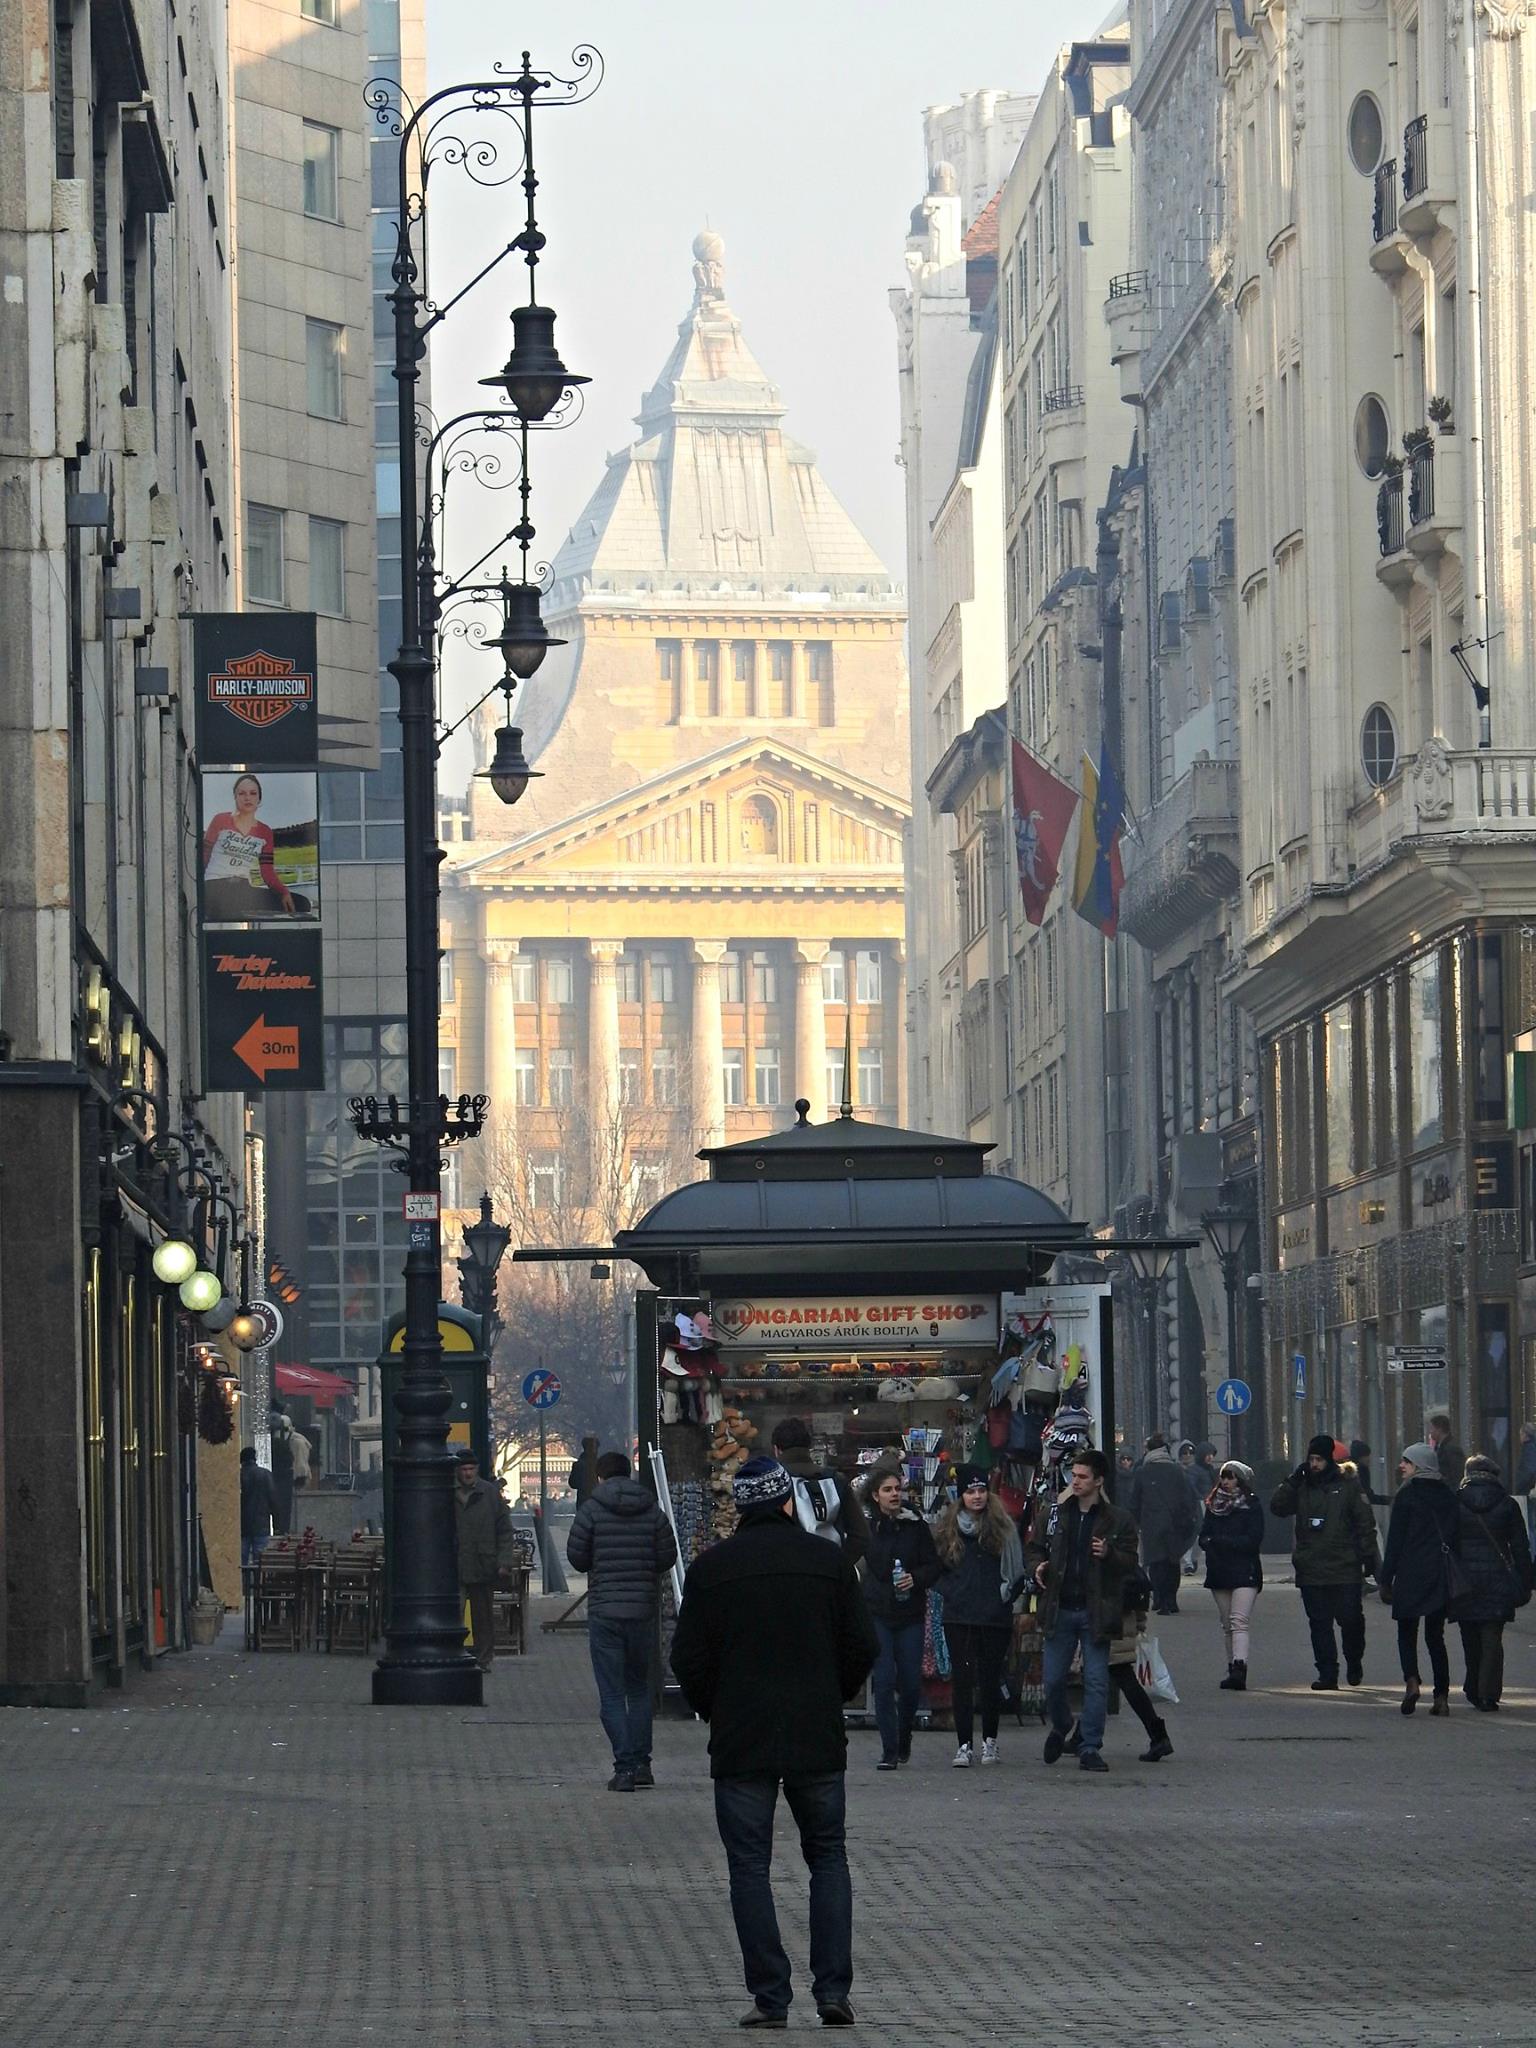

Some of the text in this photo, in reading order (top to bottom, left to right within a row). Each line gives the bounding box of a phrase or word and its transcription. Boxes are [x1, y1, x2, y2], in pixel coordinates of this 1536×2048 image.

[235, 659, 284, 675] MOTOR
[215, 679, 306, 696] HARLEY-DAVIDSON
[235, 700, 285, 721] CYCLES
[212, 955, 277, 976] Harley-
[232, 973, 316, 991] Davidson
[261, 1041, 296, 1055] 30m
[722, 1303, 986, 1325] HUNGARIAN GIFT SHOP
[760, 1324, 919, 1338] MAGYAROS ÁRÚK BOLTJA
